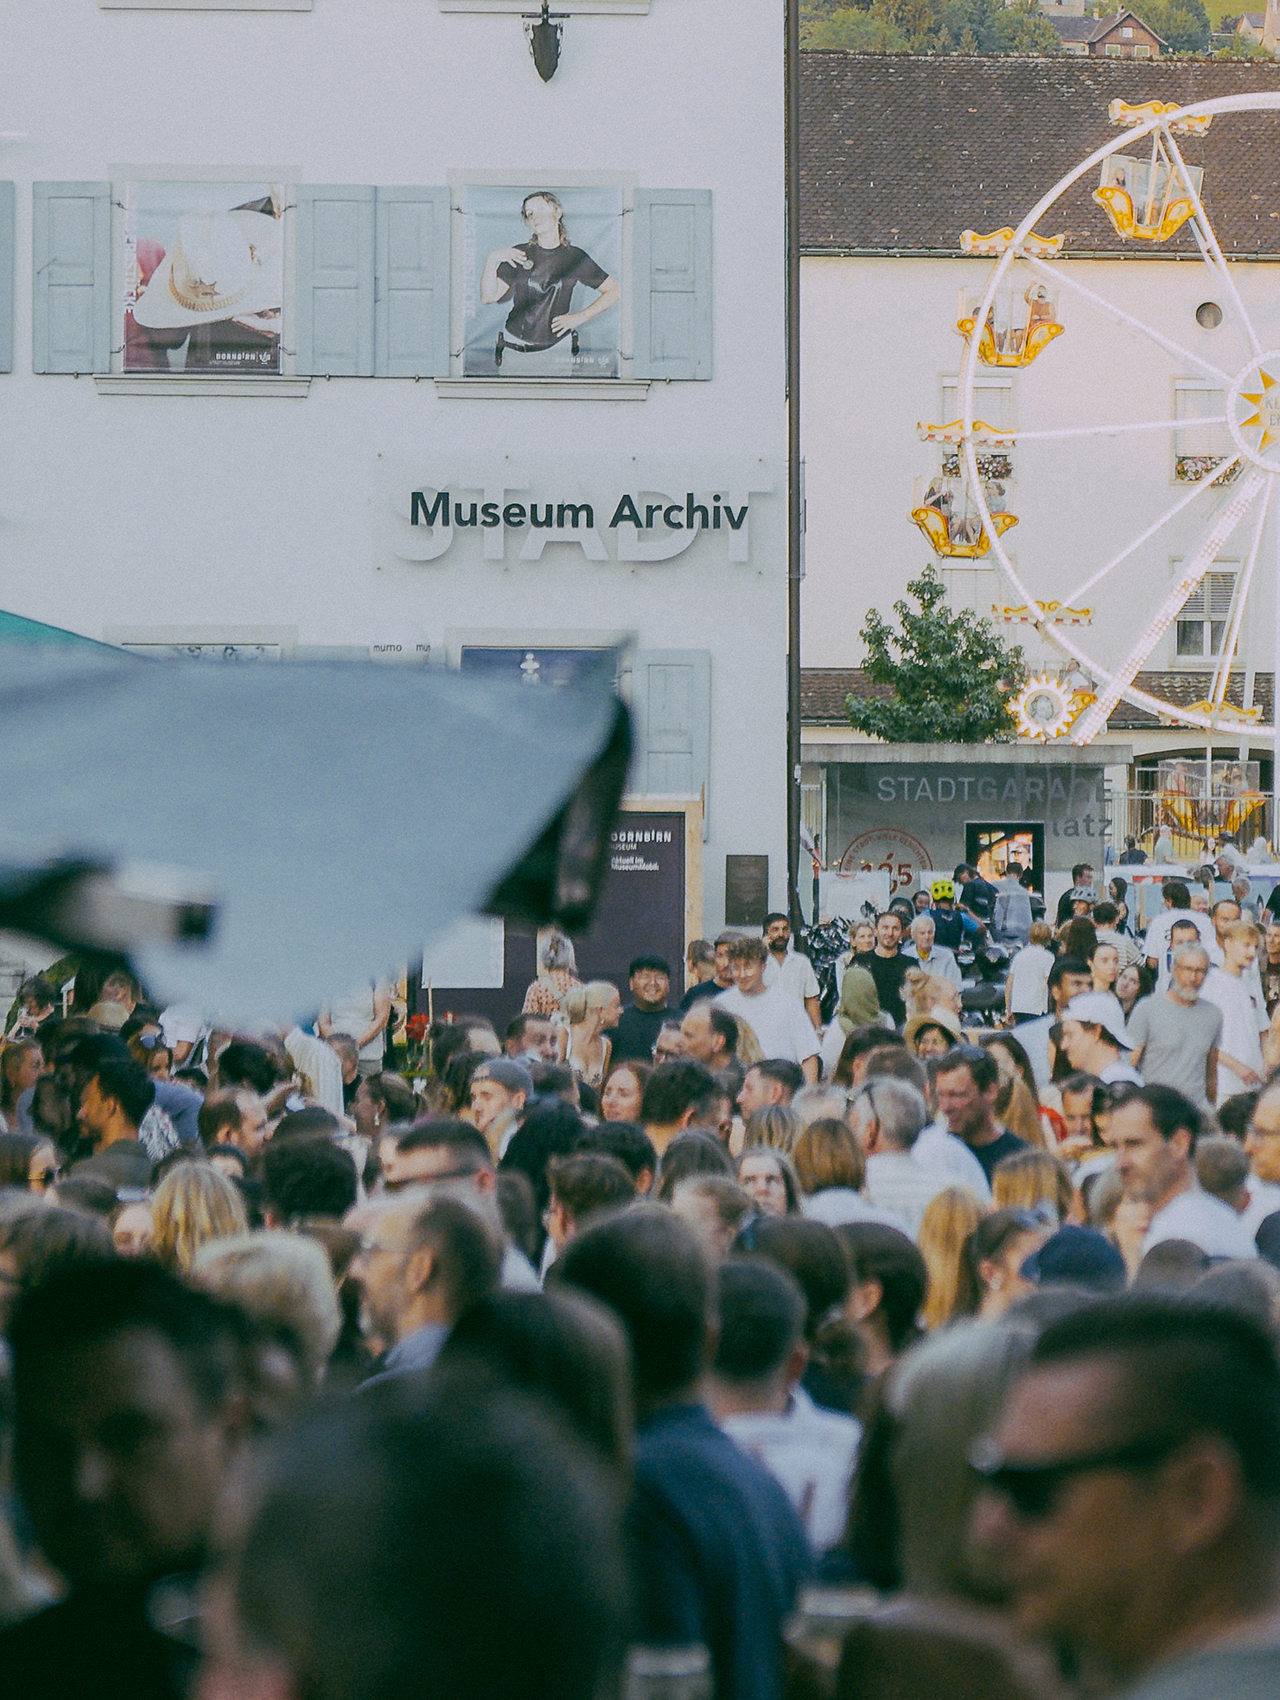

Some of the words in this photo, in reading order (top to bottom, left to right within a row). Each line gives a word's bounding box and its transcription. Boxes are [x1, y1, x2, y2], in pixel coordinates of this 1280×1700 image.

[393, 479, 777, 562] STADT
[409, 490, 595, 529] Museum
[608, 491, 751, 530] Archiv
